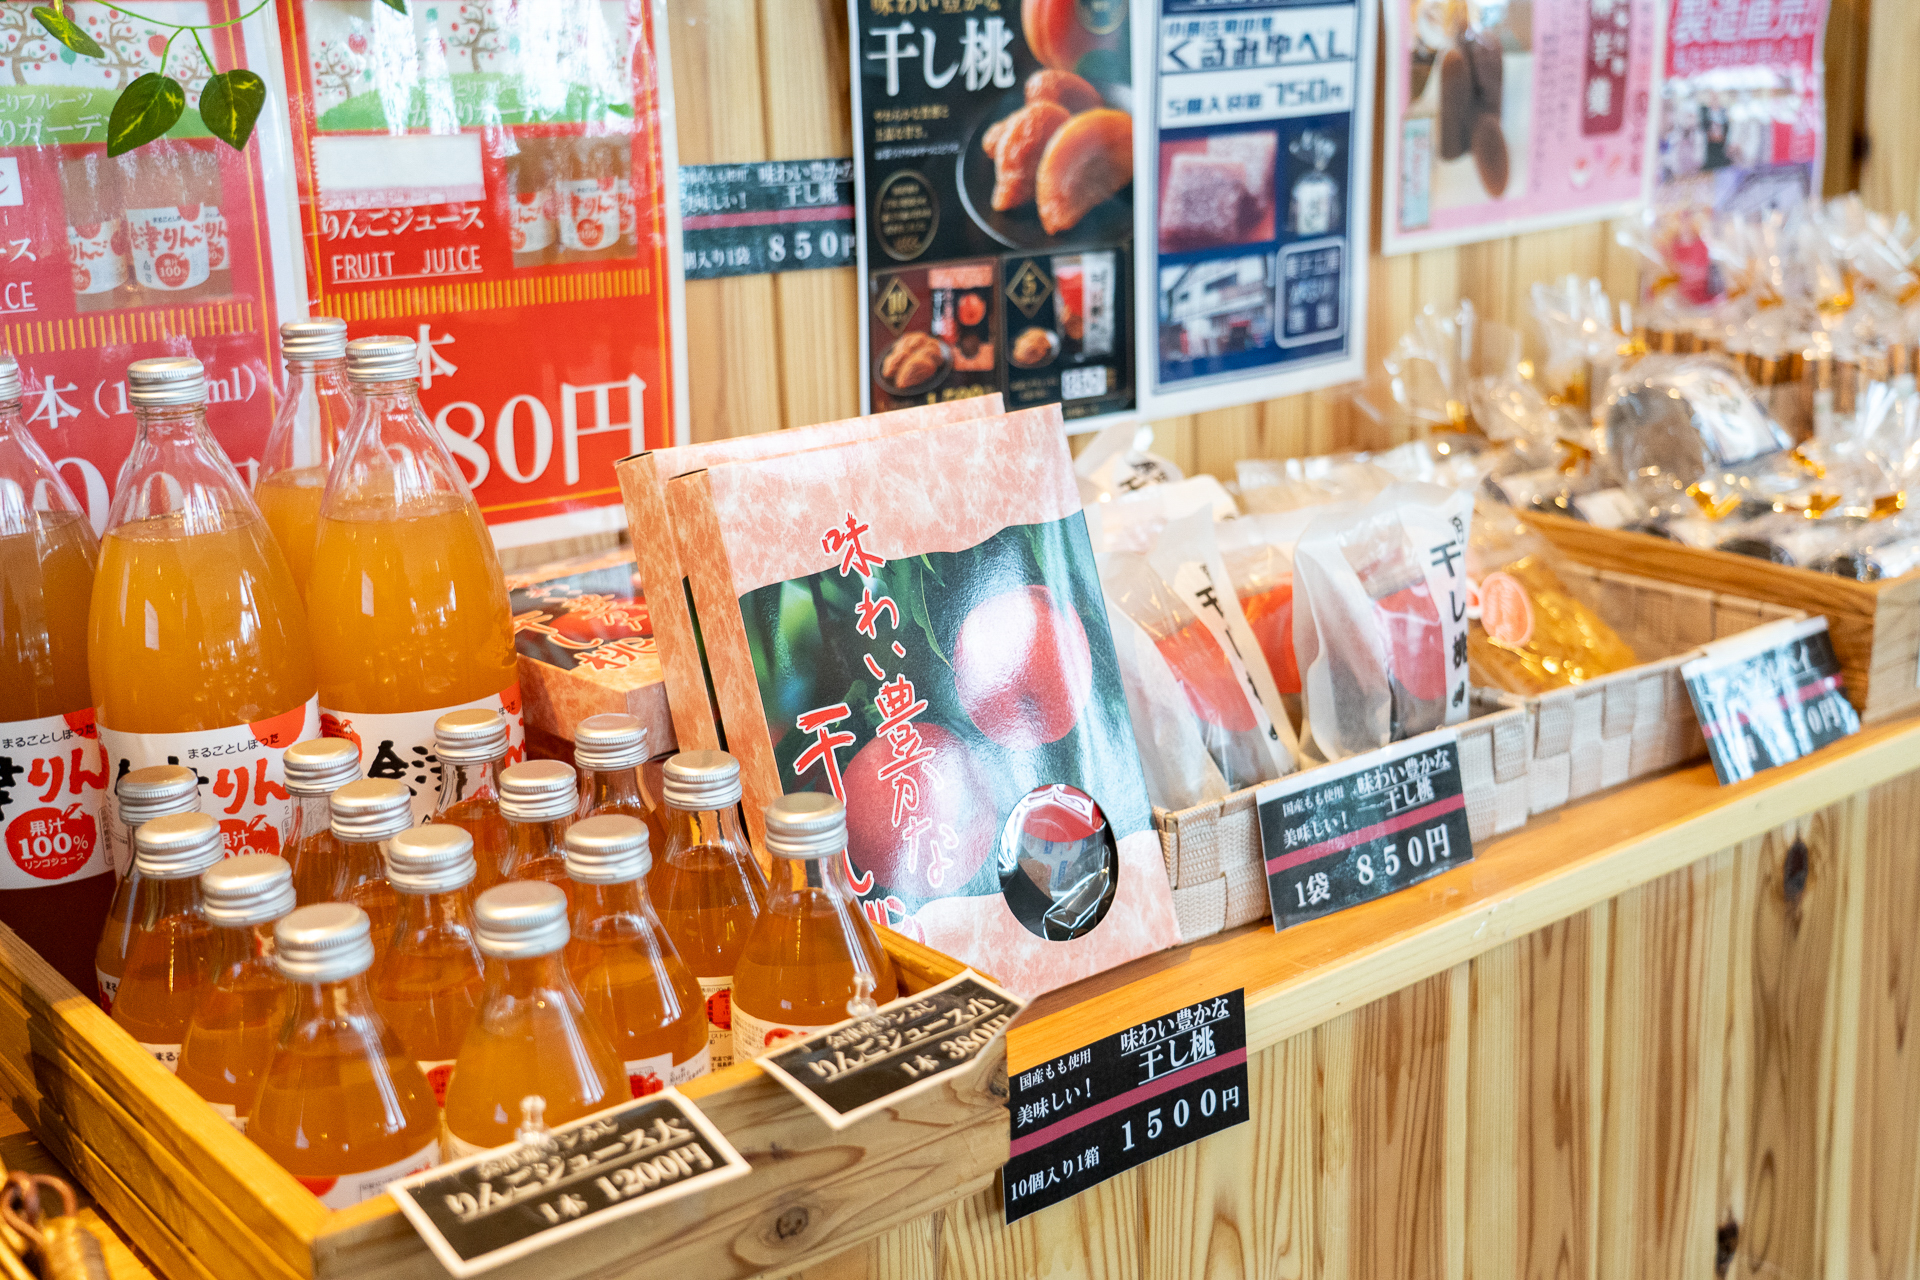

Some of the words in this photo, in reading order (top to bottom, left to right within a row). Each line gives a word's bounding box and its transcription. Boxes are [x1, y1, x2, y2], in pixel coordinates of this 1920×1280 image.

[866, 17, 1016, 97] 干し桃
[320, 206, 485, 242] りんごジュース
[332, 252, 396, 280] FRUIT
[422, 245, 482, 274] JUICE
[821, 511, 959, 888] 味わい豊かな
[1282, 785, 1345, 817] 国産もも使用
[1357, 748, 1451, 795] 味わい豊かな
[1283, 811, 1348, 849] 美味しい!
[1387, 778, 1436, 814] 干し桃
[19, 832, 89, 860] 100%
[30, 817, 65, 837] 果汁
[1295, 871, 1331, 908] 1袋
[1356, 823, 1451, 886] 850円
[808, 997, 997, 1079] りんごジュース小
[900, 1054, 940, 1078] 1本
[1017, 1077, 1092, 1129] 美味しい!
[1138, 1025, 1217, 1079] 干し桃
[1019, 1048, 1092, 1092] 国産もも使用
[1121, 997, 1230, 1052] 味わい豊かな
[445, 1116, 696, 1220] りんごジュース大
[537, 1193, 589, 1224] 1本
[595, 1142, 714, 1201] 1200円
[1011, 1146, 1100, 1201] 10個入り1箱
[1121, 1085, 1240, 1152] 1500円
